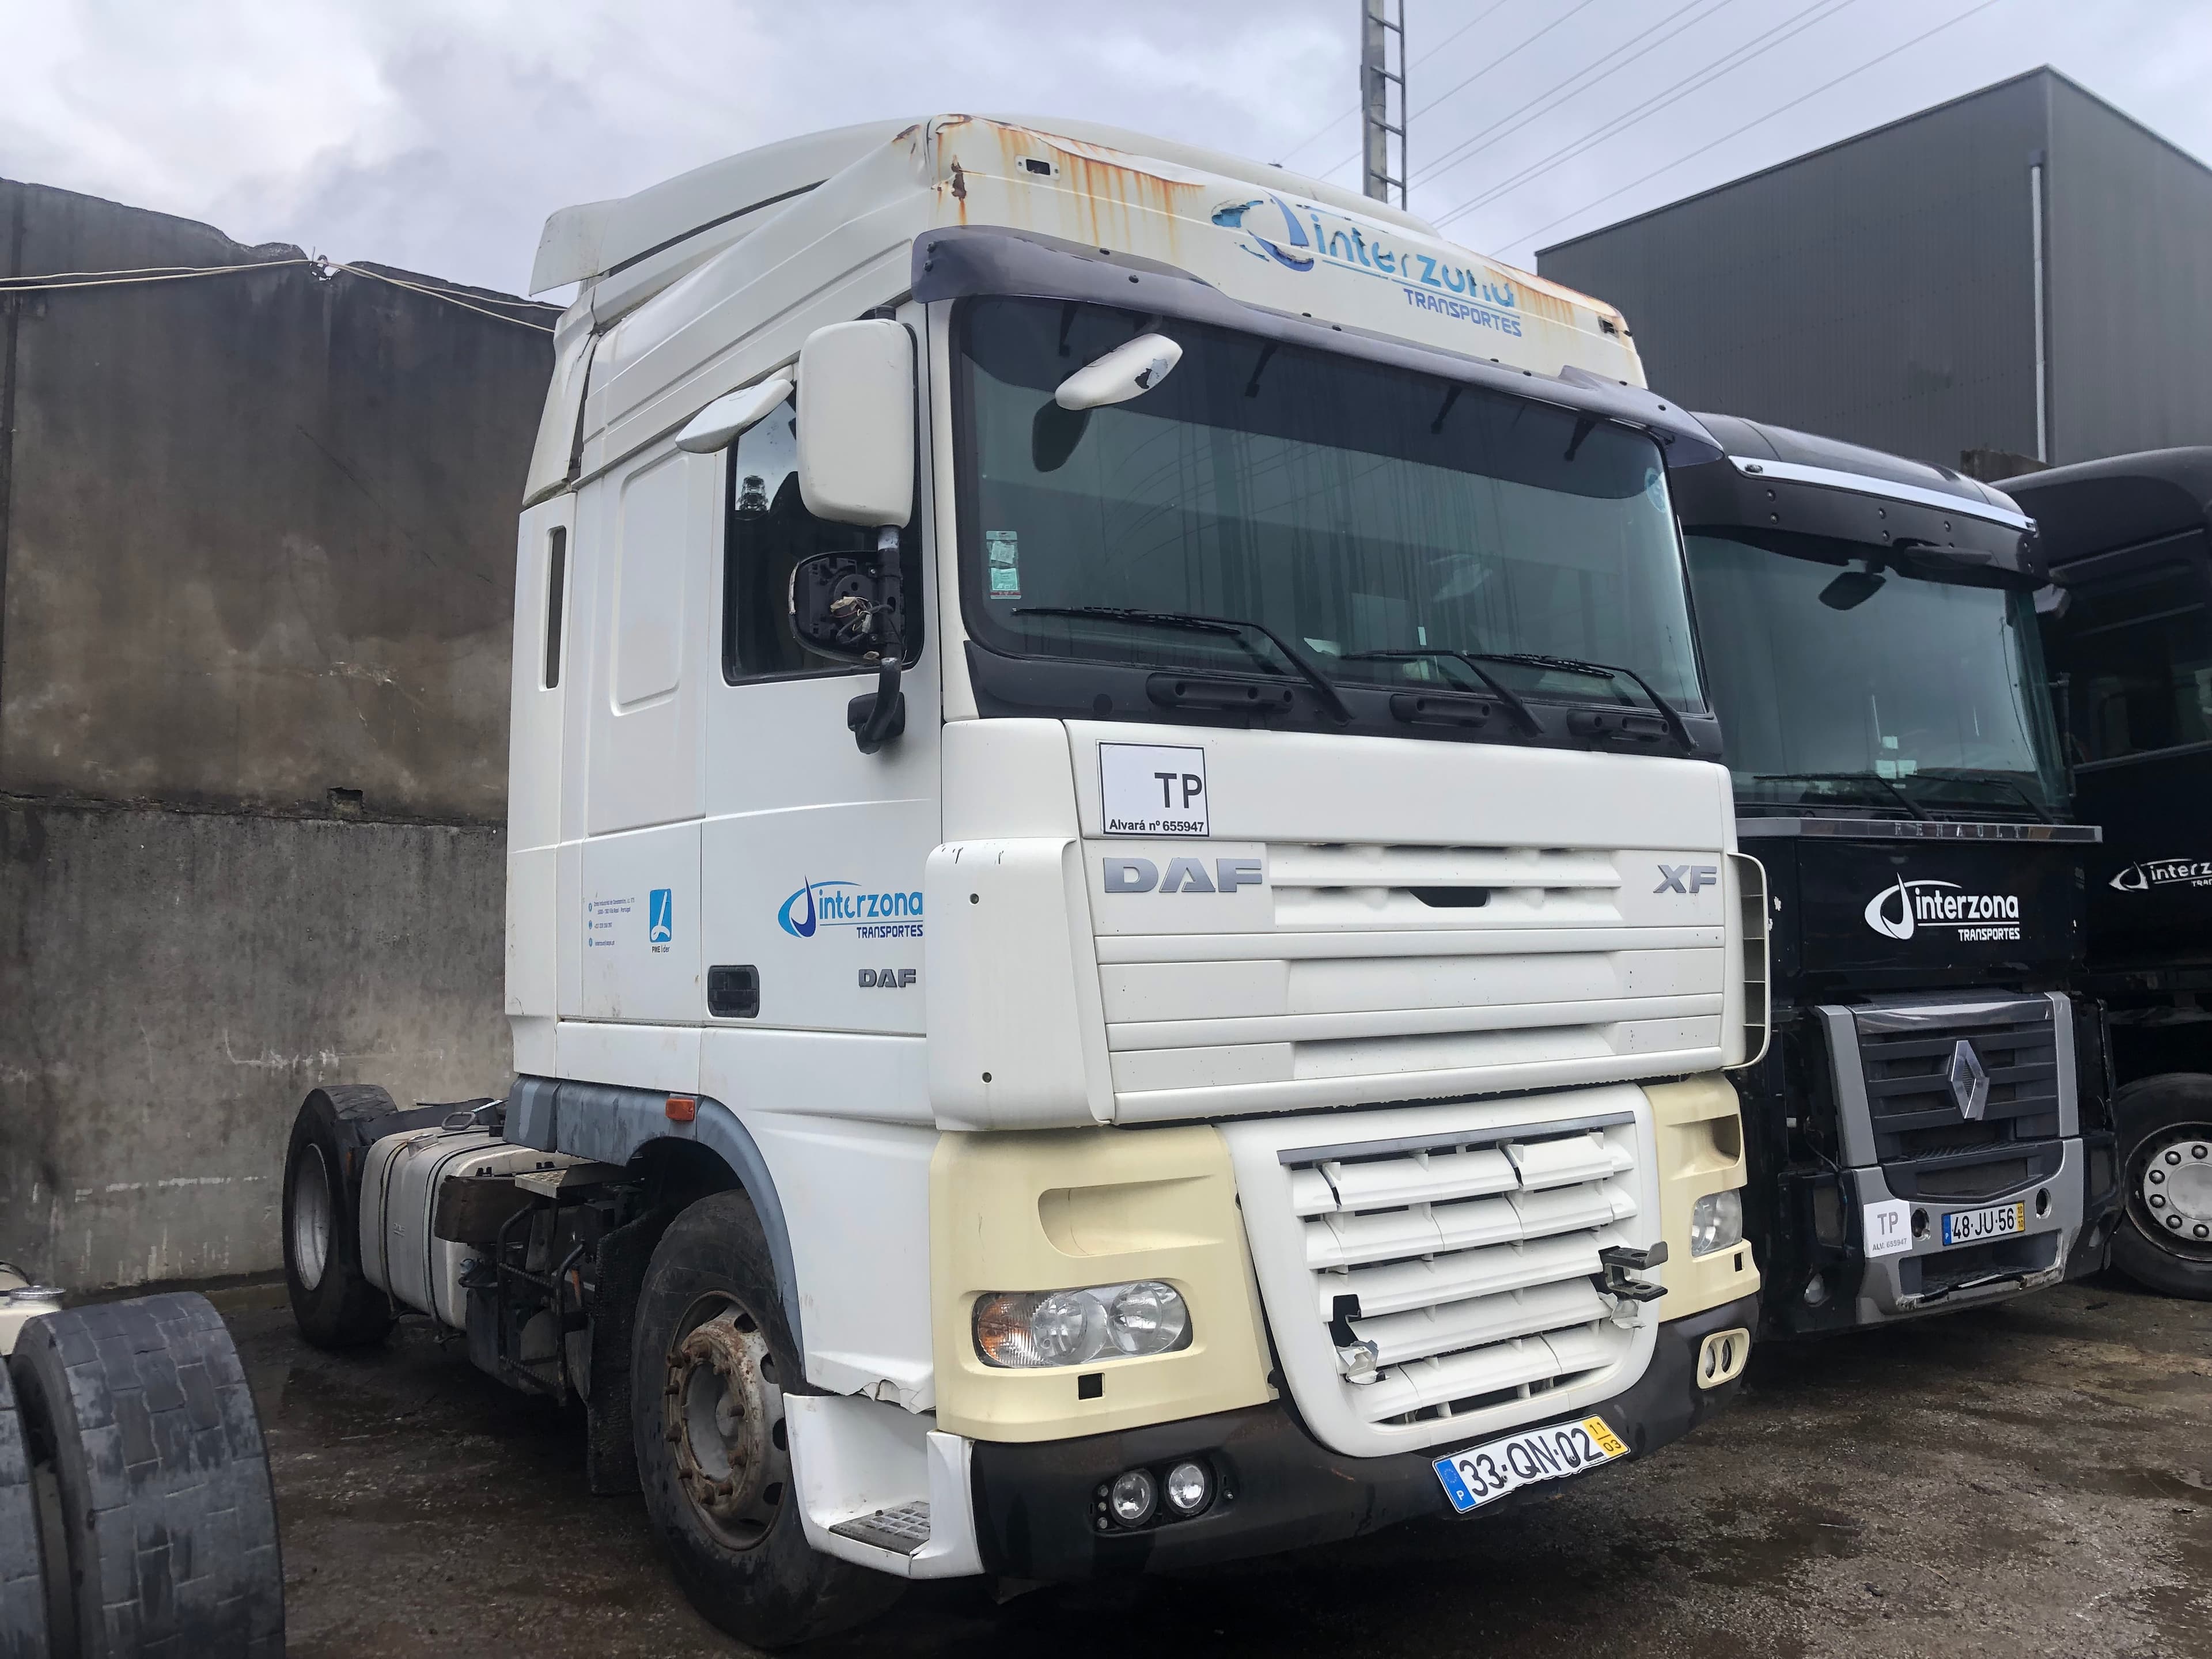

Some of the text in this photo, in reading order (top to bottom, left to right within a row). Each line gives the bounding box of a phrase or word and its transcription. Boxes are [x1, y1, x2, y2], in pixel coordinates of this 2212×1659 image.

[1403, 288, 1522, 338] TRANSPORTES
[1154, 772, 1202, 809] TP
[1109, 819, 1205, 832] Alvará nº 655947
[1103, 857, 1263, 893] DAF
[1653, 865, 1717, 893] XF
[819, 889, 923, 920] interzona
[1914, 887, 2019, 919] interzona
[856, 925, 923, 938] TRANSPORTES
[1957, 928, 2020, 942] TRANSPORTES
[652, 945, 661, 953] PME
[858, 969, 916, 988] DAF
[1877, 1212, 1898, 1236] TP
[1872, 1238, 1907, 1251] ALV. 655947
[1589, 1422, 1605, 1435] 11
[1603, 1440, 1622, 1452] 03
[1456, 1490, 1465, 1501] P
